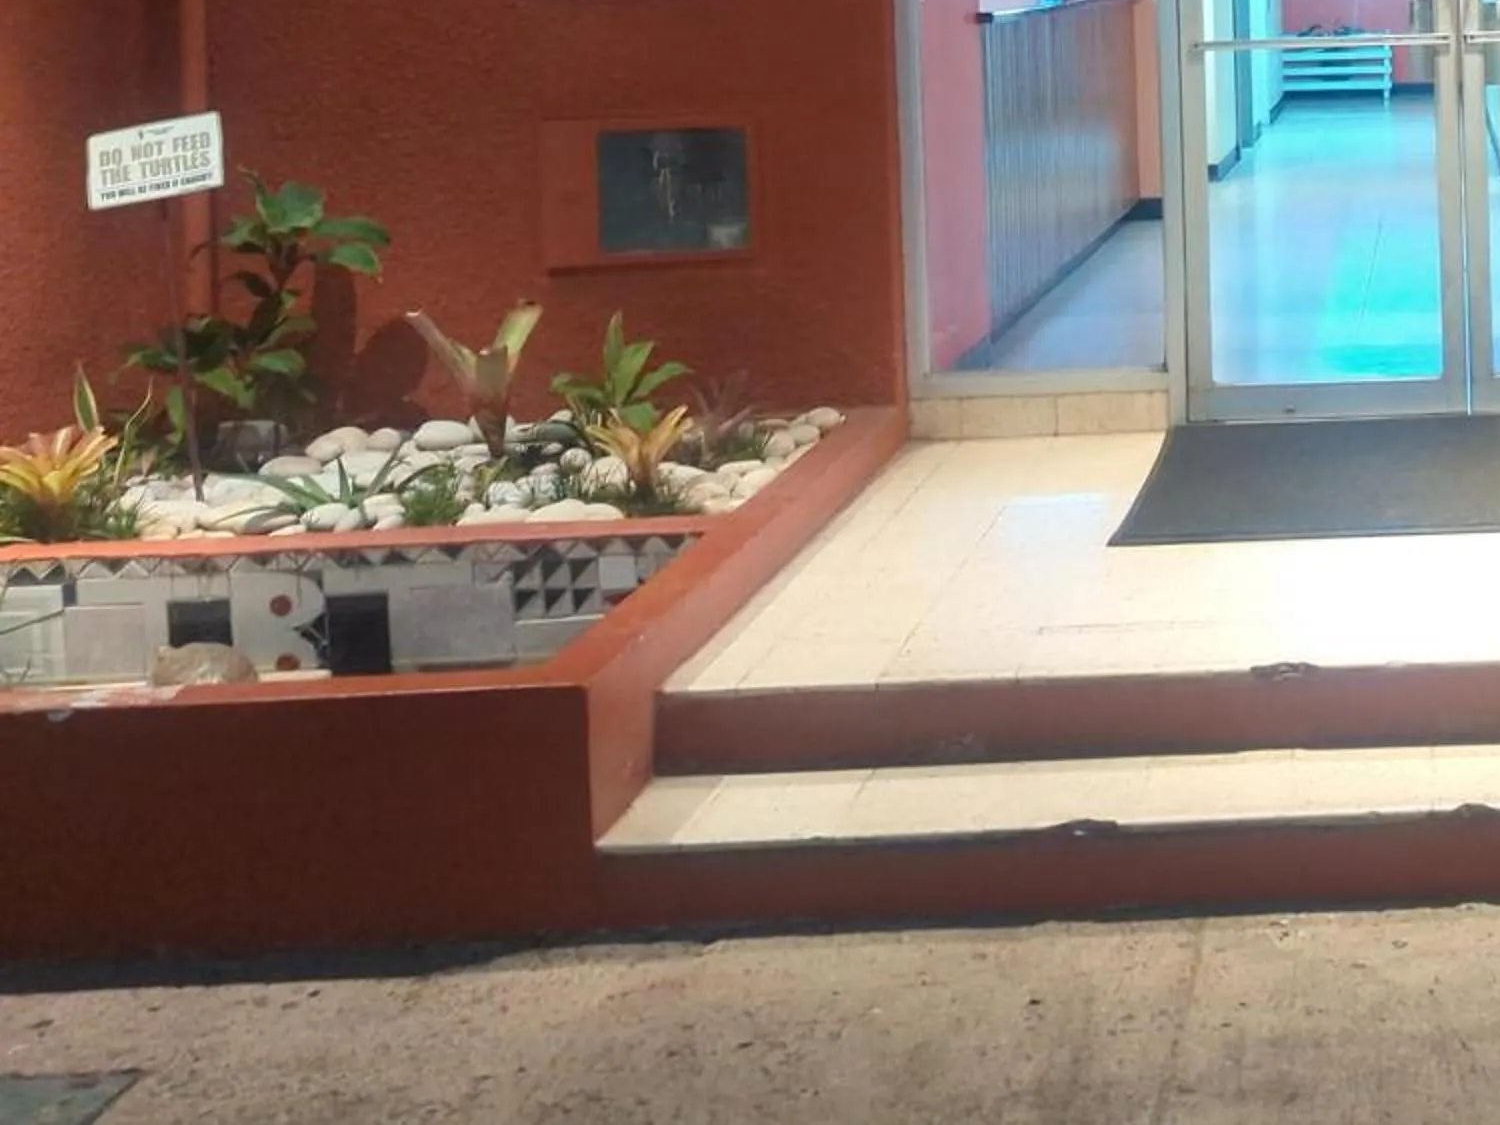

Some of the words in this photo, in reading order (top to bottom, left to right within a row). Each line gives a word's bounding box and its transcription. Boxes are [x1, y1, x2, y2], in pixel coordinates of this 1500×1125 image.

[99, 147, 123, 168] DO
[130, 139, 165, 162] NOT
[172, 130, 211, 153] FEED
[100, 163, 132, 188] THE
[138, 150, 212, 179] TURTLES
